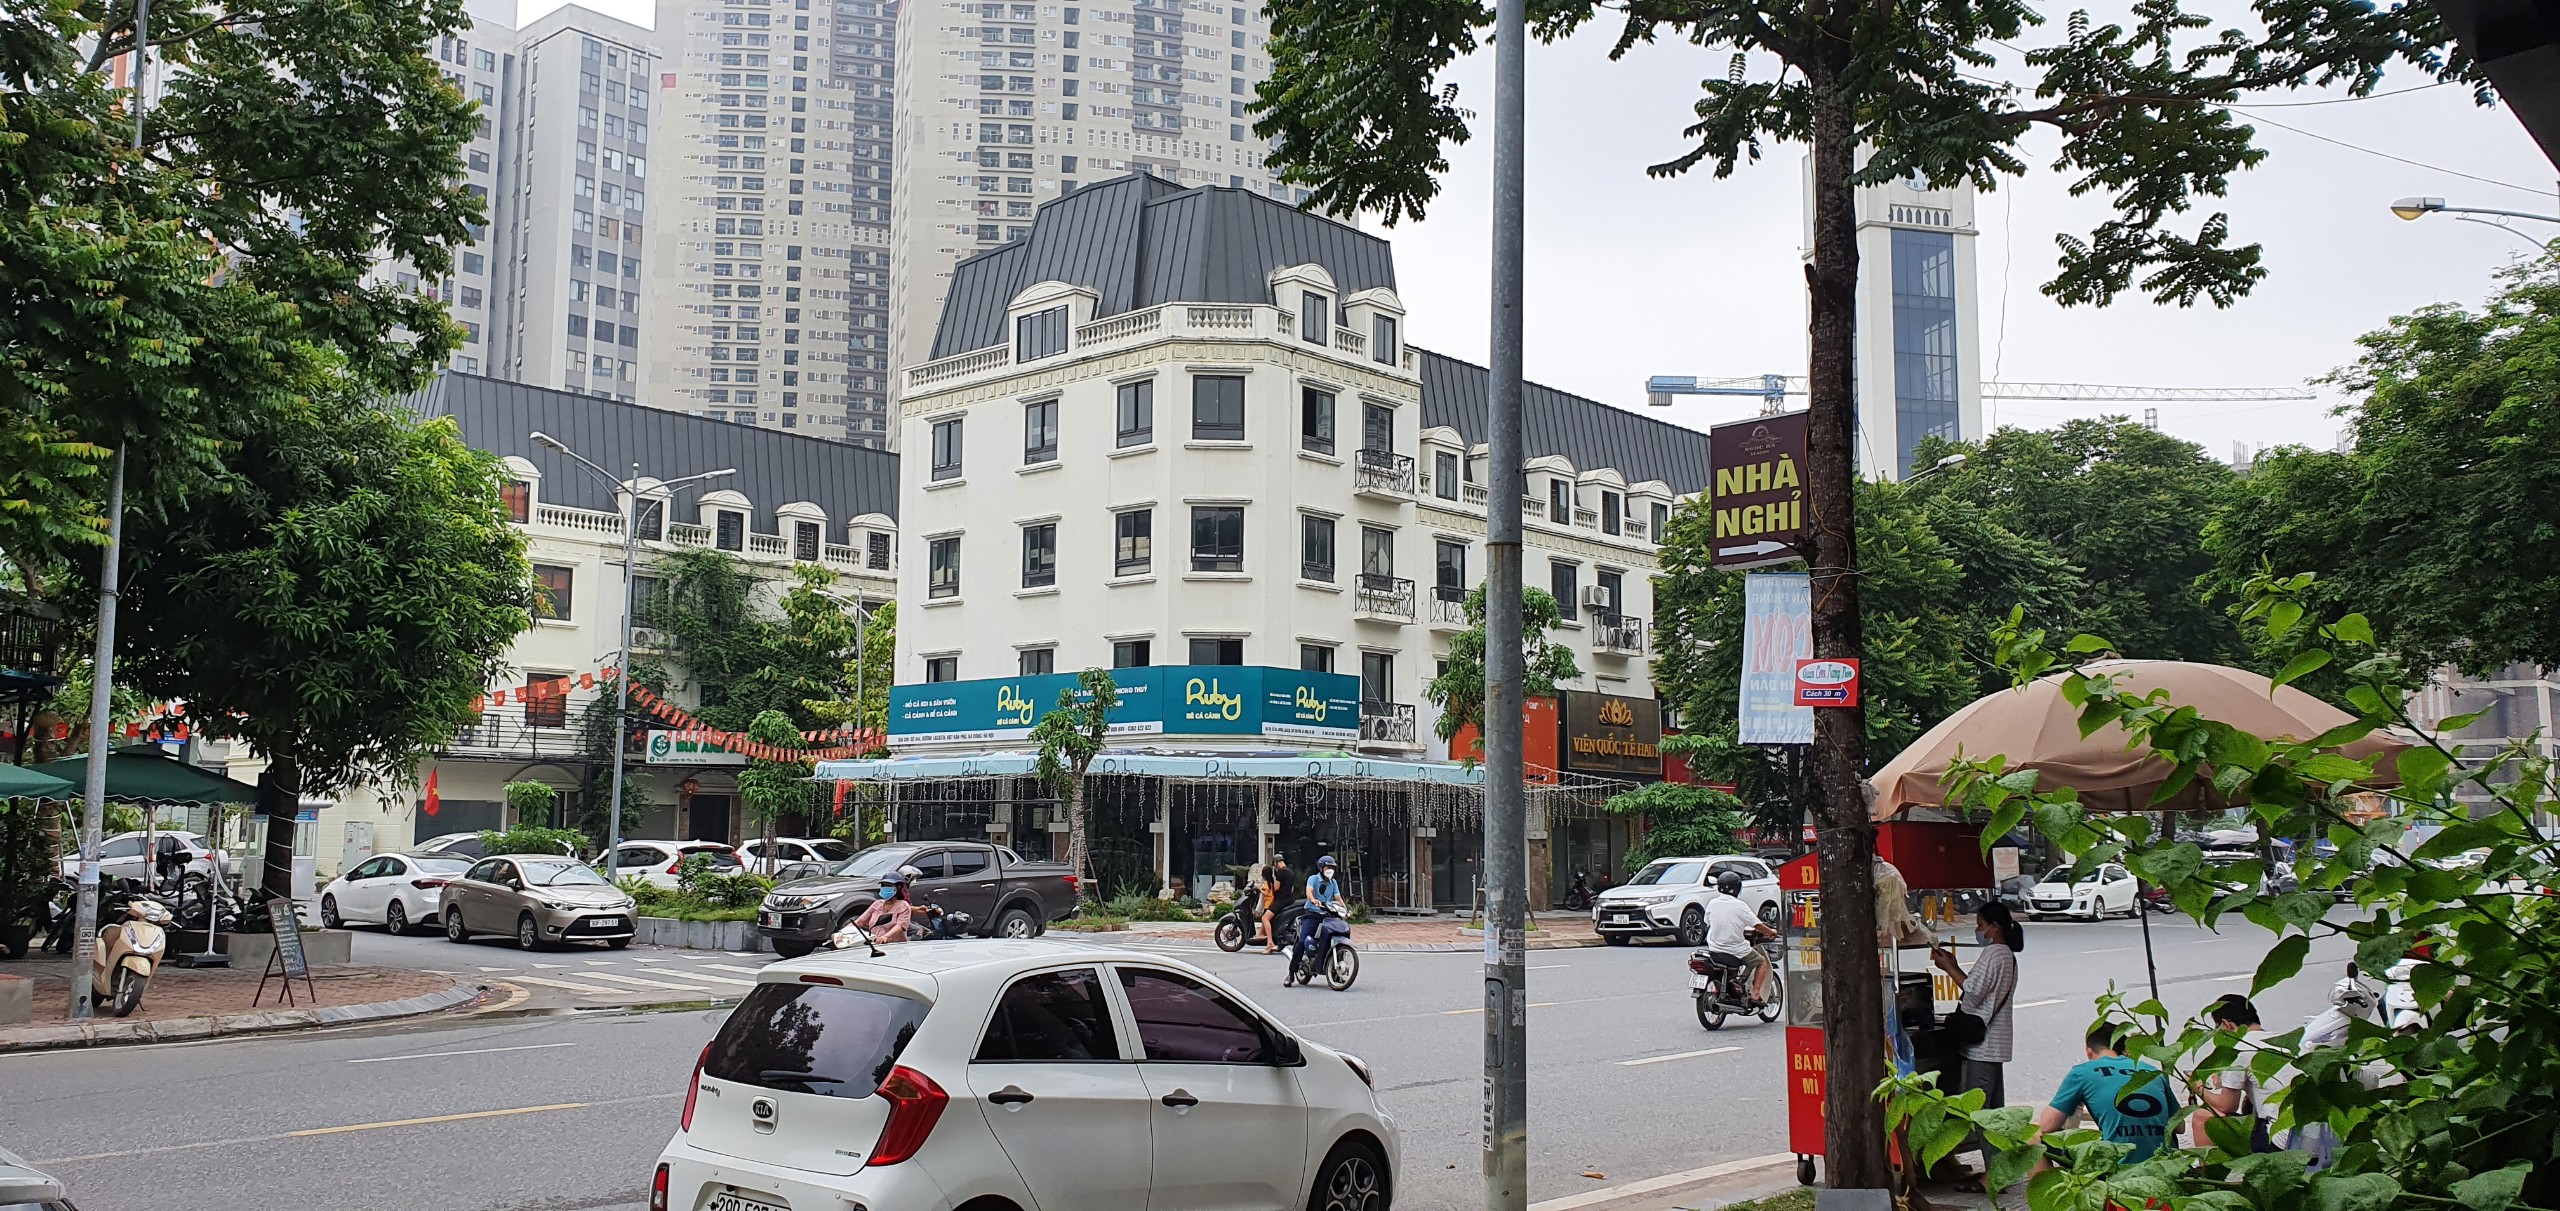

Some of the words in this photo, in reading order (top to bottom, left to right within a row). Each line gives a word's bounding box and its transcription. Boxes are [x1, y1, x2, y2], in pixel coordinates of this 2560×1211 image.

[1716, 453, 1800, 497] NHÀ
[1716, 489, 1802, 538] NGHỈ
[997, 685, 1034, 725] Ruby
[1186, 678, 1241, 720] Ruby
[1296, 685, 1327, 722] Ruby
[1572, 733, 1596, 756] VIỆN
[1597, 732, 1621, 757] QUỐC
[1622, 733, 1637, 757] TẾ
[1802, 1073, 1819, 1095] MÌ
[755, 1103, 770, 1116] KIA
